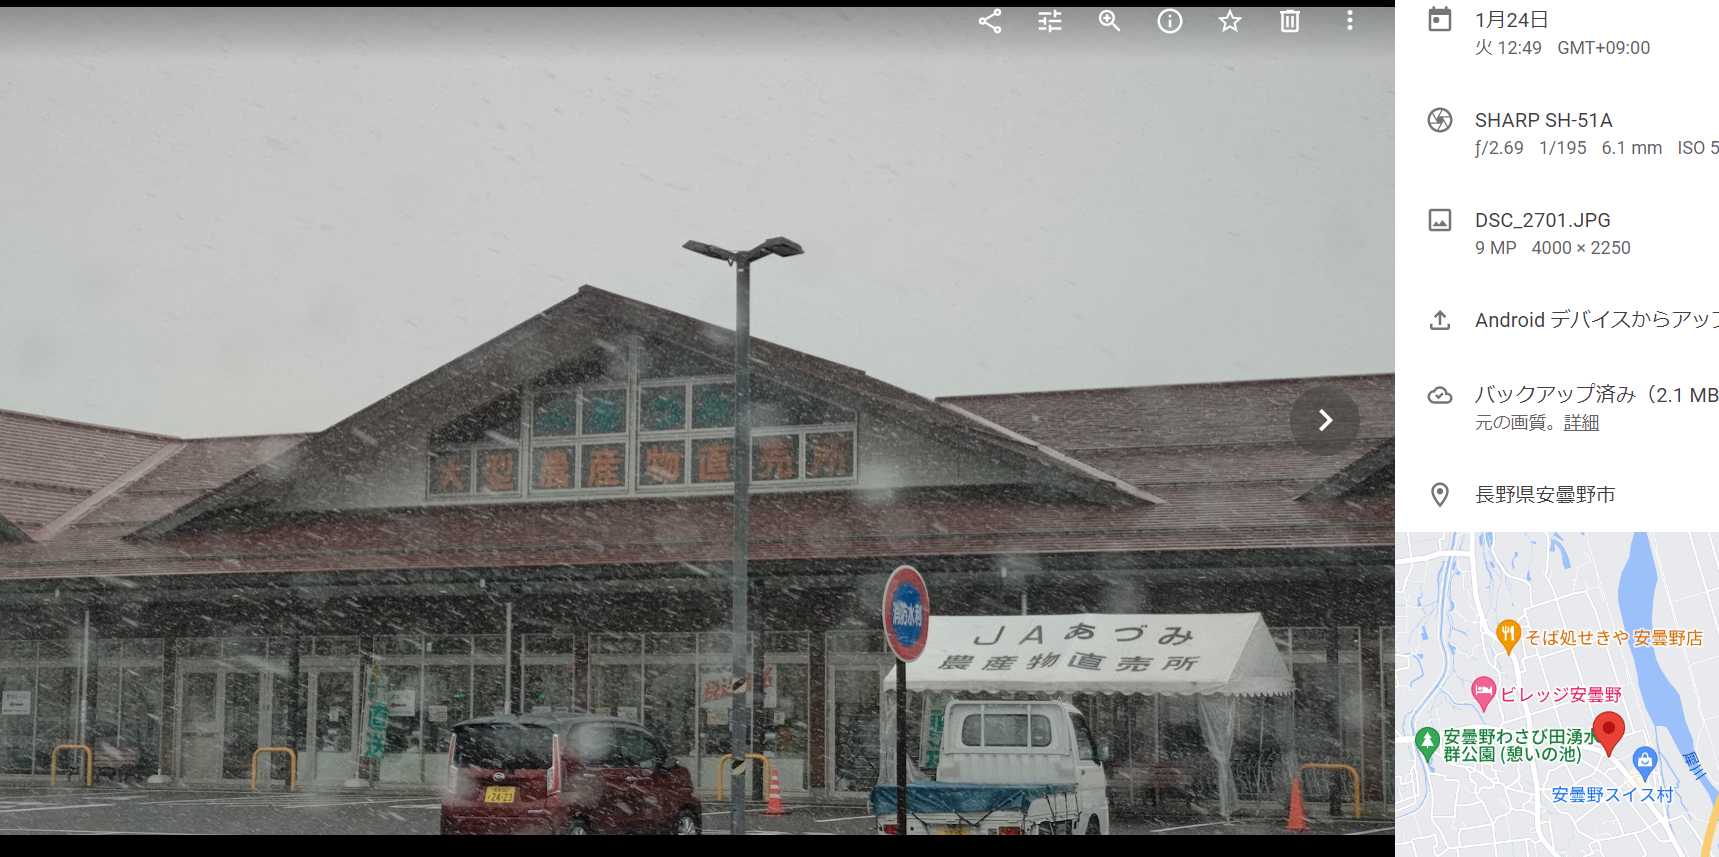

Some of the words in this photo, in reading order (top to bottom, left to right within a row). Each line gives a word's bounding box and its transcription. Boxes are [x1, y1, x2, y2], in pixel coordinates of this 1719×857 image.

[436, 437, 849, 492] 大型農産物直売所
[892, 601, 923, 627] 消防水利
[937, 651, 1202, 673] 農産物直売所
